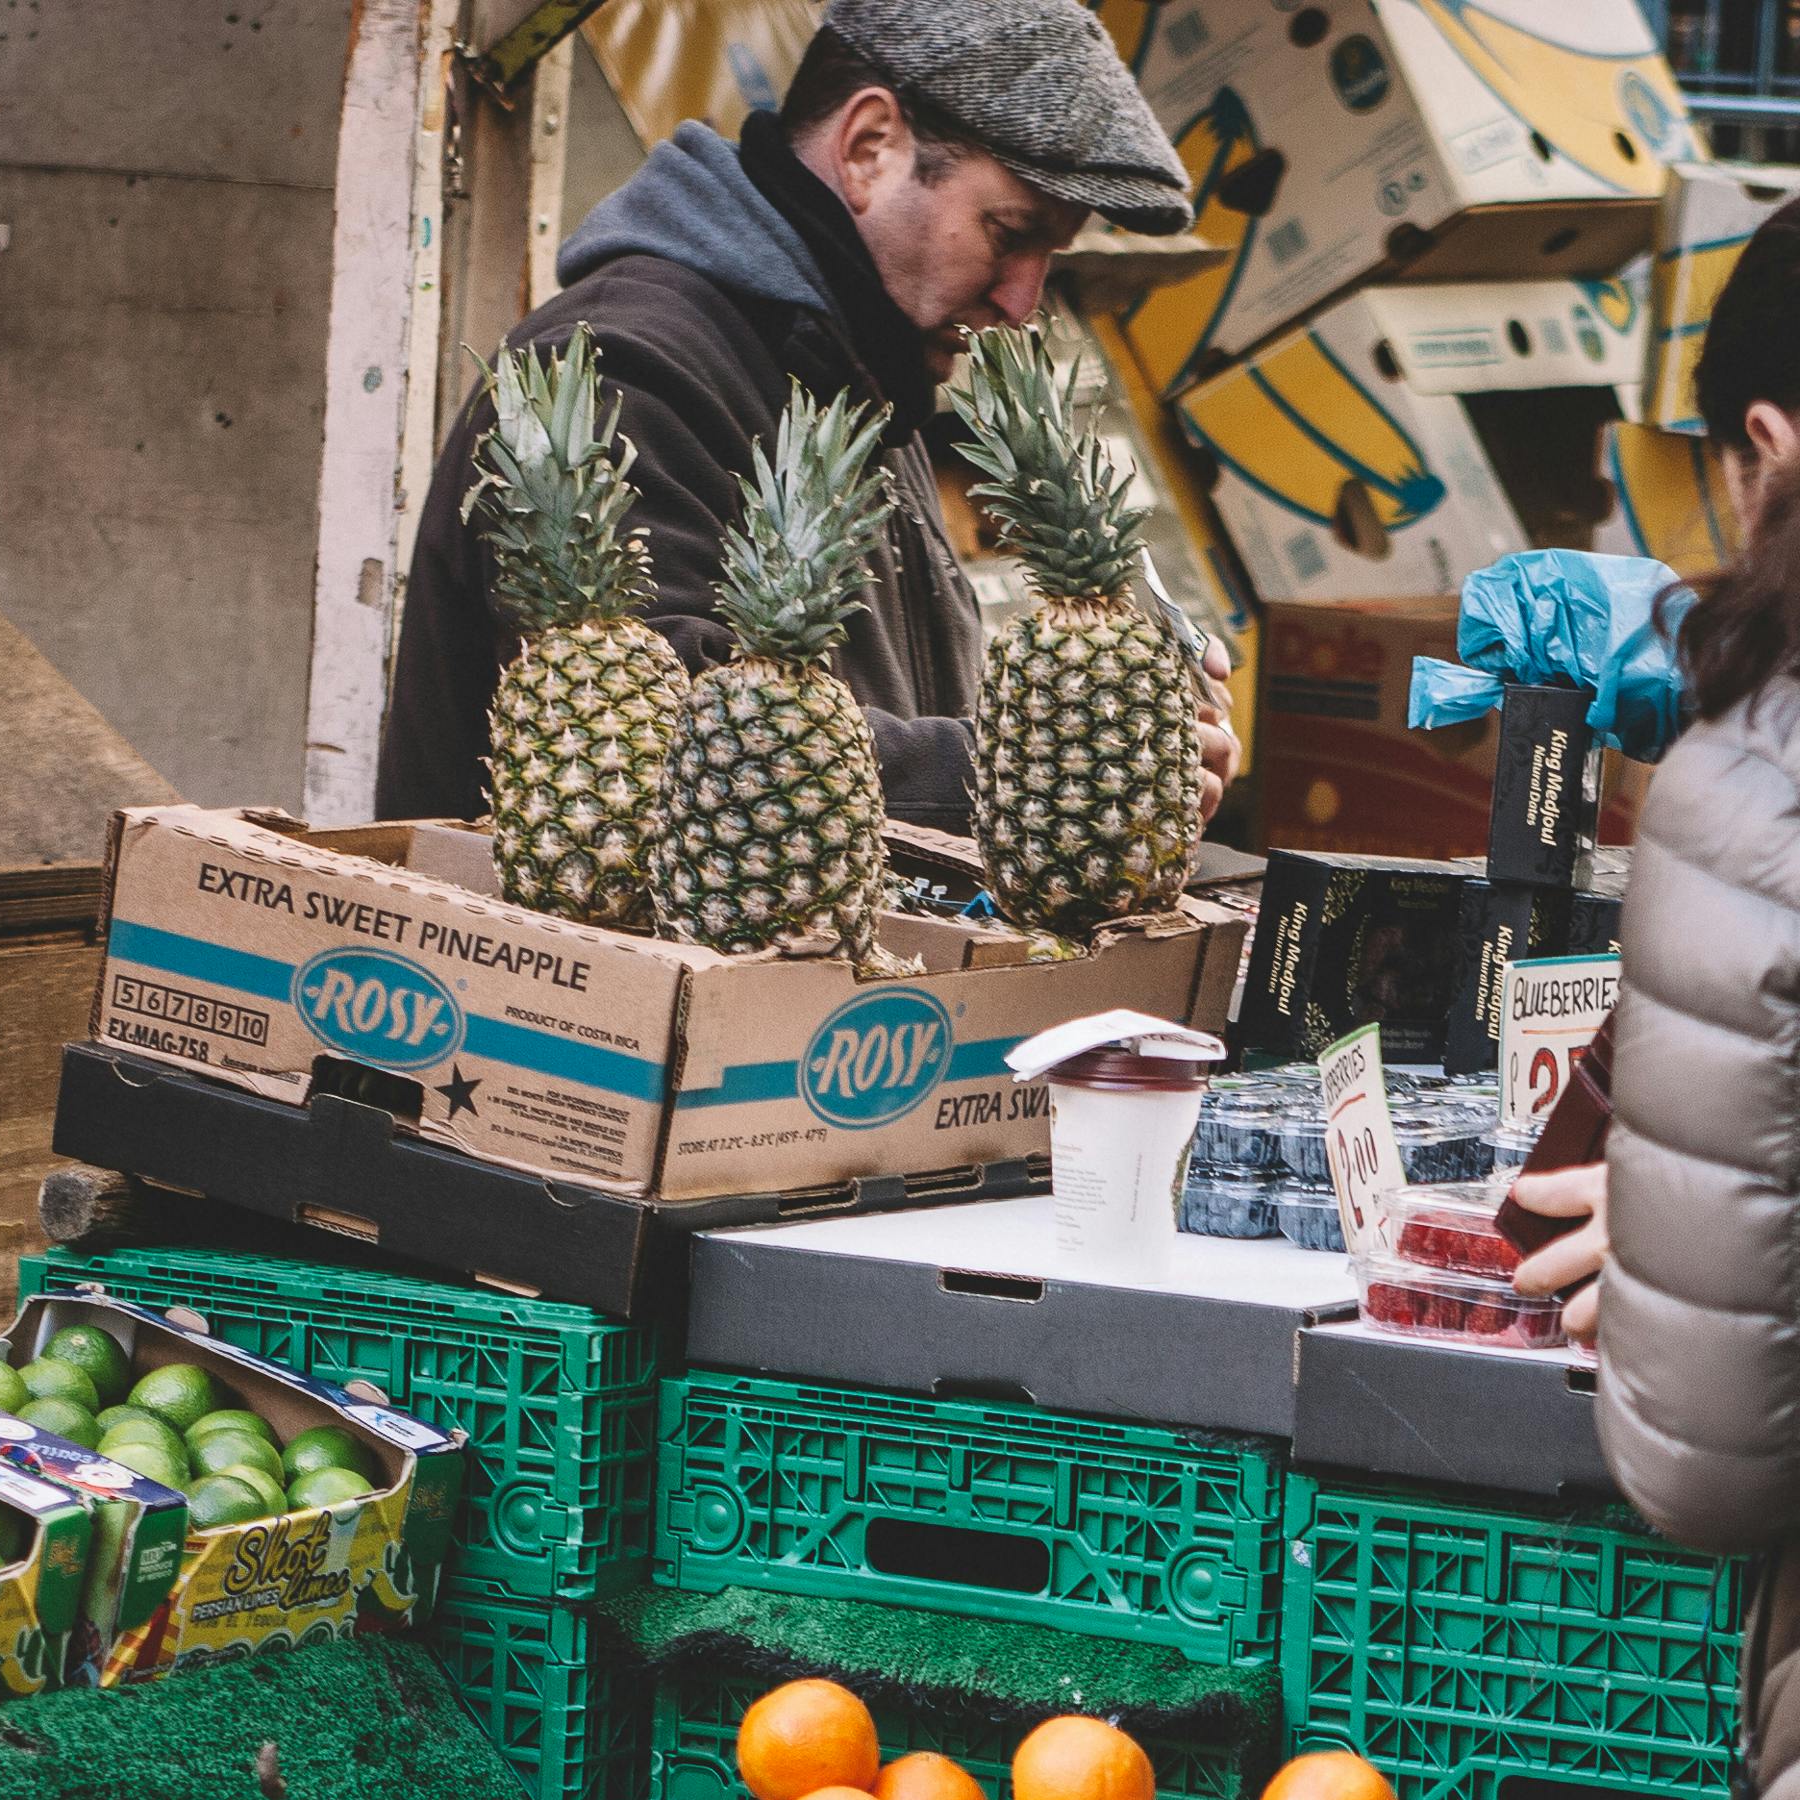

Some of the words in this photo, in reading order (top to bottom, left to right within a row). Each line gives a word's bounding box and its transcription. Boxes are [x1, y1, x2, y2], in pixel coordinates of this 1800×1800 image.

[1531, 744, 1547, 792] Natural
[1545, 729, 1569, 771] King
[1526, 790, 1542, 827] Dates
[1540, 771, 1564, 847] Medjoul
[198, 863, 294, 914] EXTRA
[303, 890, 413, 943] SWEET
[419, 919, 591, 993] PINEAPPLE
[1274, 914, 1290, 965] Natural
[1289, 900, 1308, 942] King
[1493, 924, 1514, 966] King
[1268, 961, 1282, 995] Dates
[1278, 942, 1302, 1017] Medjoul
[1480, 939, 1493, 989] Natural
[119, 982, 135, 1004] 5
[146, 990, 161, 1011] 6
[171, 996, 186, 1018] 7
[195, 1003, 210, 1024] 8
[218, 1010, 233, 1030] 9
[242, 1015, 264, 1040] 10
[315, 966, 440, 1050] ROSY
[1474, 984, 1487, 1022] Dates
[1487, 963, 1505, 1041] Medjoul
[1512, 976, 1618, 1021] BLUEBERRIE
[504, 1005, 559, 1030] PRODUCT
[561, 1020, 576, 1033] OF
[576, 1023, 614, 1045] COSTA
[615, 1032, 642, 1052] RICA
[817, 1019, 939, 1102] ROSY
[933, 1096, 1001, 1131] EXTRA
[222, 1509, 333, 1597] Shot
[190, 1597, 245, 1623] PERSIAN
[244, 1588, 282, 1612] LIMES
